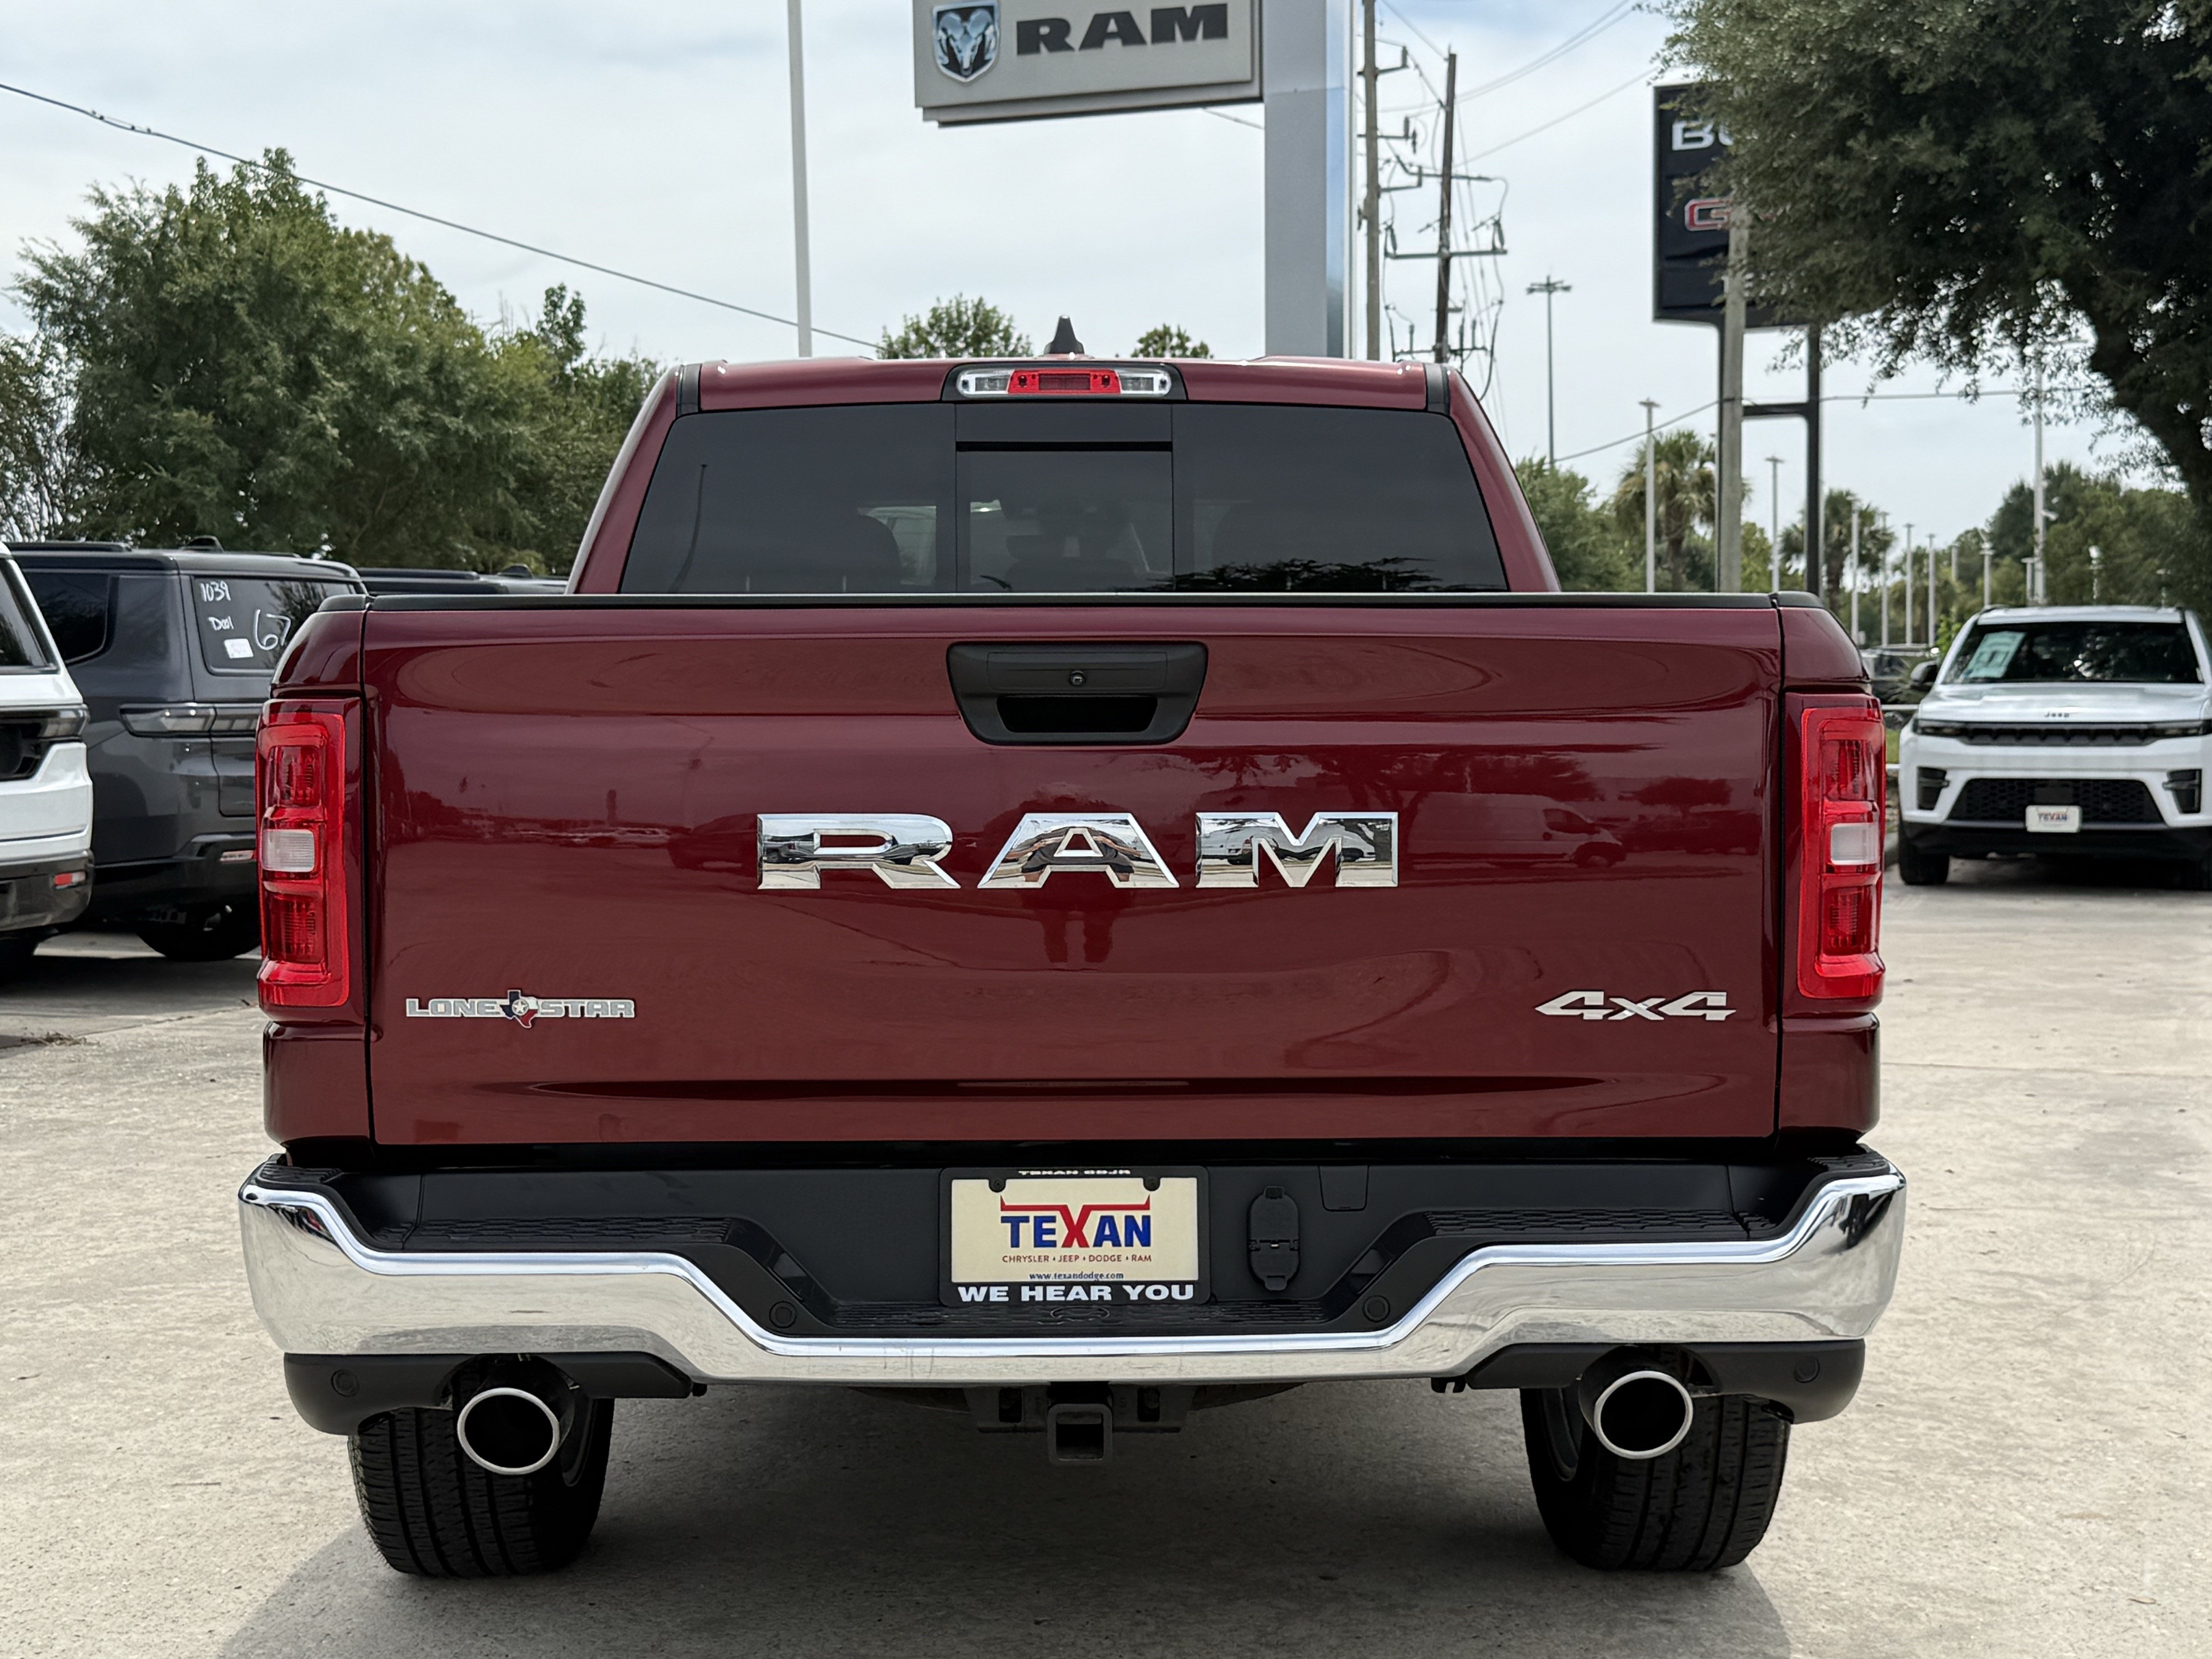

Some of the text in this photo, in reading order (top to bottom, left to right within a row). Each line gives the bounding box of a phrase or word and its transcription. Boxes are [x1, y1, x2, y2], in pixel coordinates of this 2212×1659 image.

[1016, 3, 1228, 56] RAM
[254, 609, 291, 650] 67
[756, 811, 1399, 890] RAM
[406, 998, 635, 1018] LONE STAR
[1535, 990, 1736, 1020] 4x4
[1000, 1204, 1151, 1248] TEXAN
[958, 1285, 1194, 1302] WE HEAR YOU
[1029, 1271, 1124, 1281] www.texandodge.com
